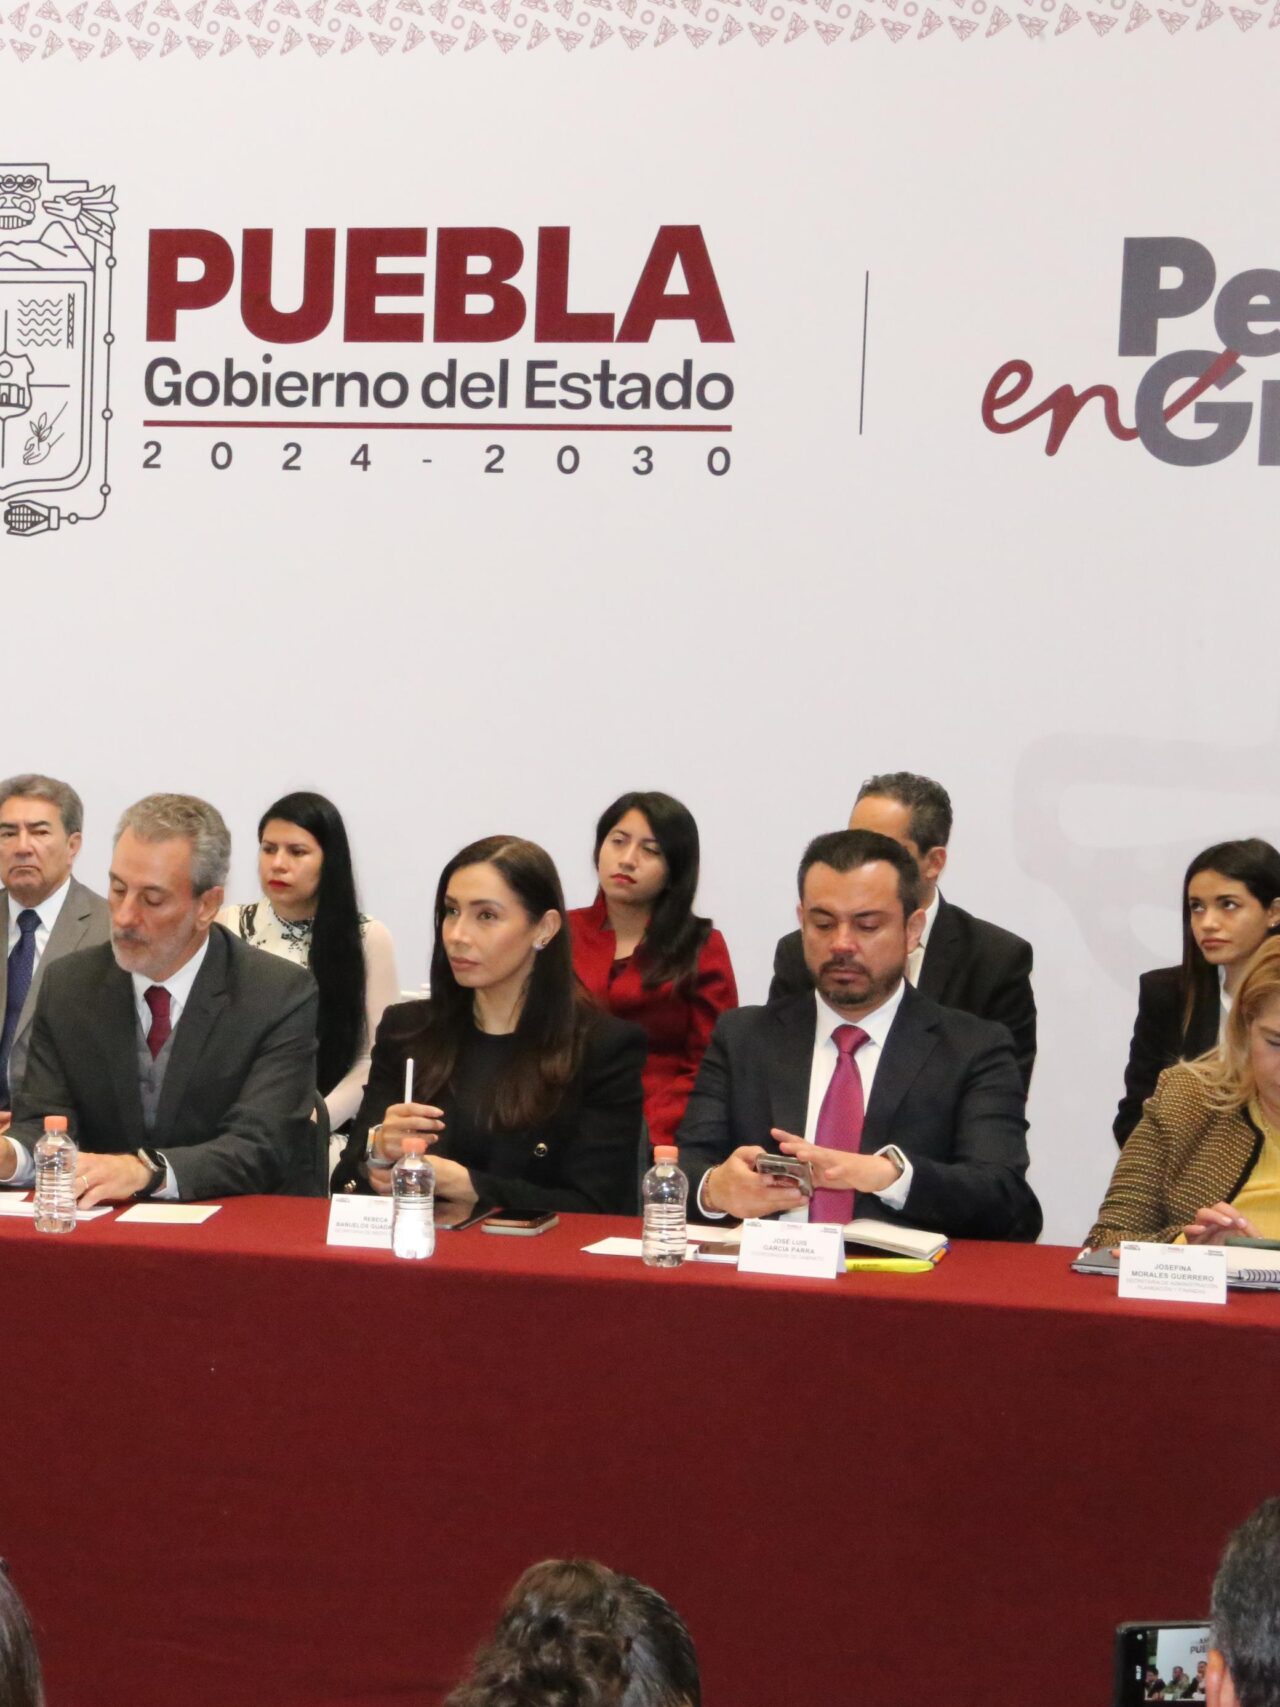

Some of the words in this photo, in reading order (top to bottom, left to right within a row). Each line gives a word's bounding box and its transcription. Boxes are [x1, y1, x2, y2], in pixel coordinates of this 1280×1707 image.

[145, 224, 736, 344] PUEBLA
[143, 354, 410, 409] Gobierno
[420, 358, 510, 410] del
[524, 359, 736, 411] Estado
[1131, 1270, 1169, 1279] MORALES
[1170, 1272, 1215, 1282] GUERRERO
[1154, 1263, 1192, 1272] JOSEFINA
